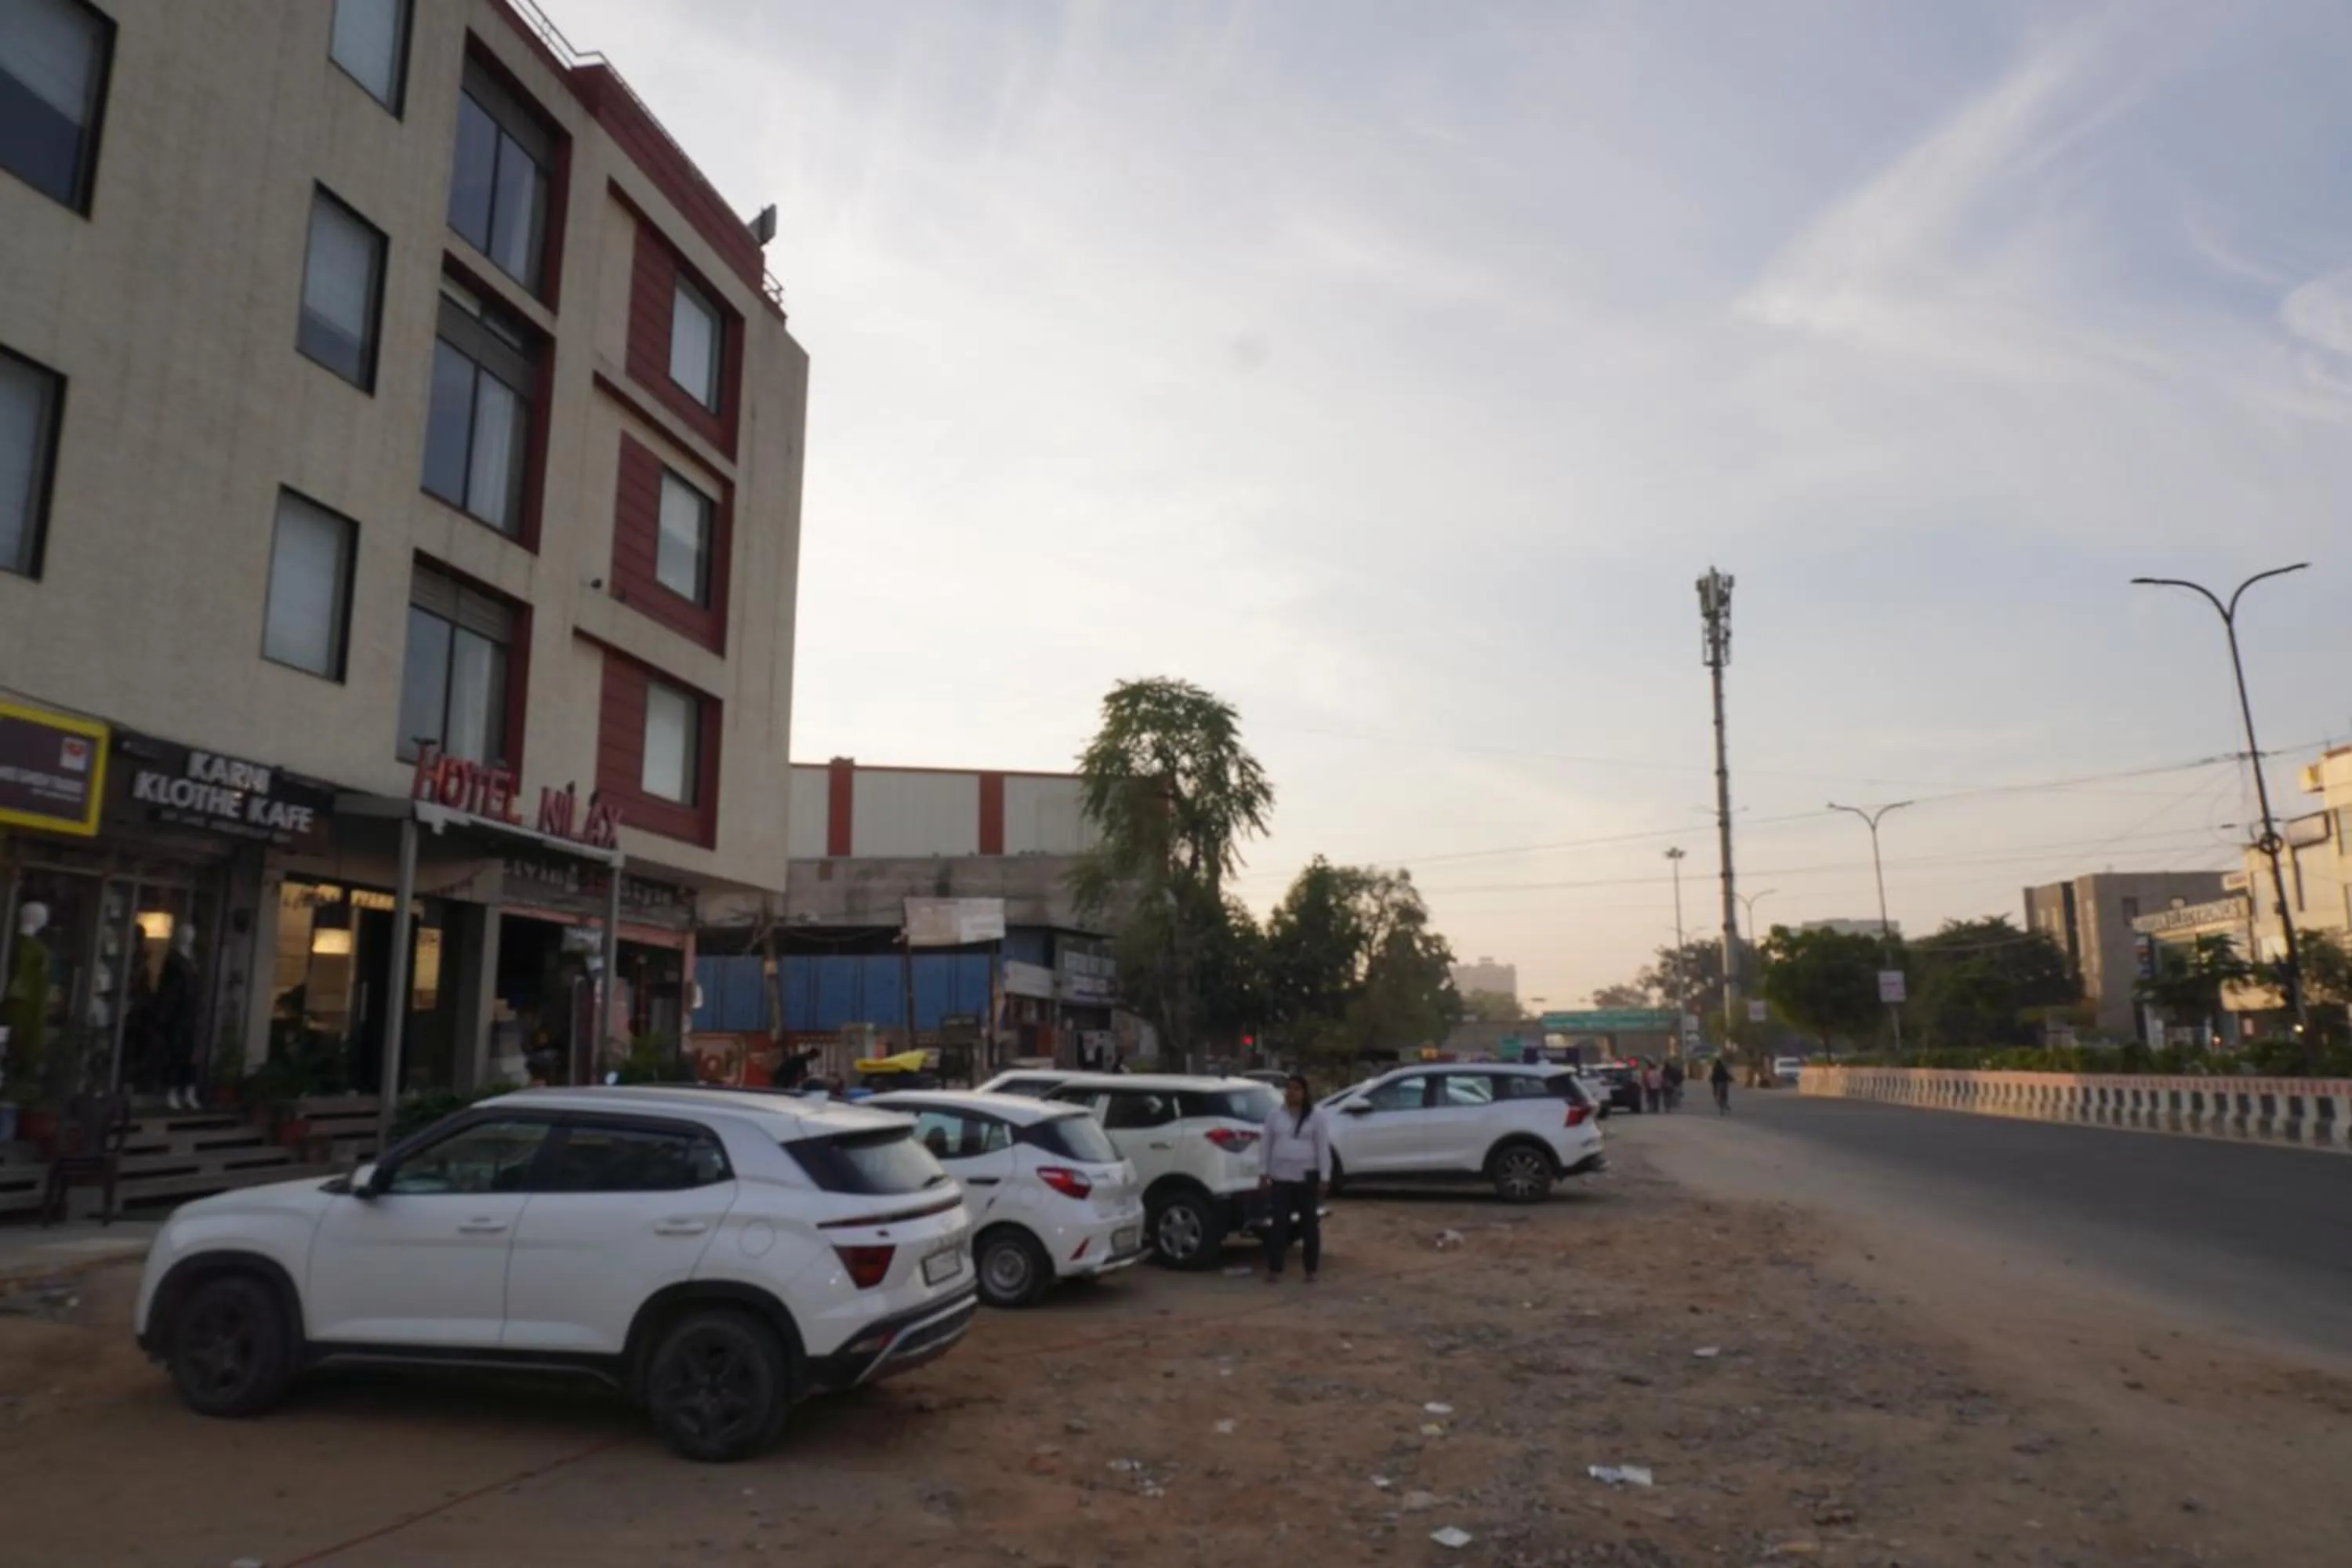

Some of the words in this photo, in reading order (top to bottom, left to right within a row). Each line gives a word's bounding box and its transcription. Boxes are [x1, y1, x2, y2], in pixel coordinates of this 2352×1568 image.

[132, 771, 243, 818] KLOTHE
[247, 795, 314, 833] KAFE
[187, 752, 271, 796] KARNI
[413, 746, 523, 826] HOTEL
